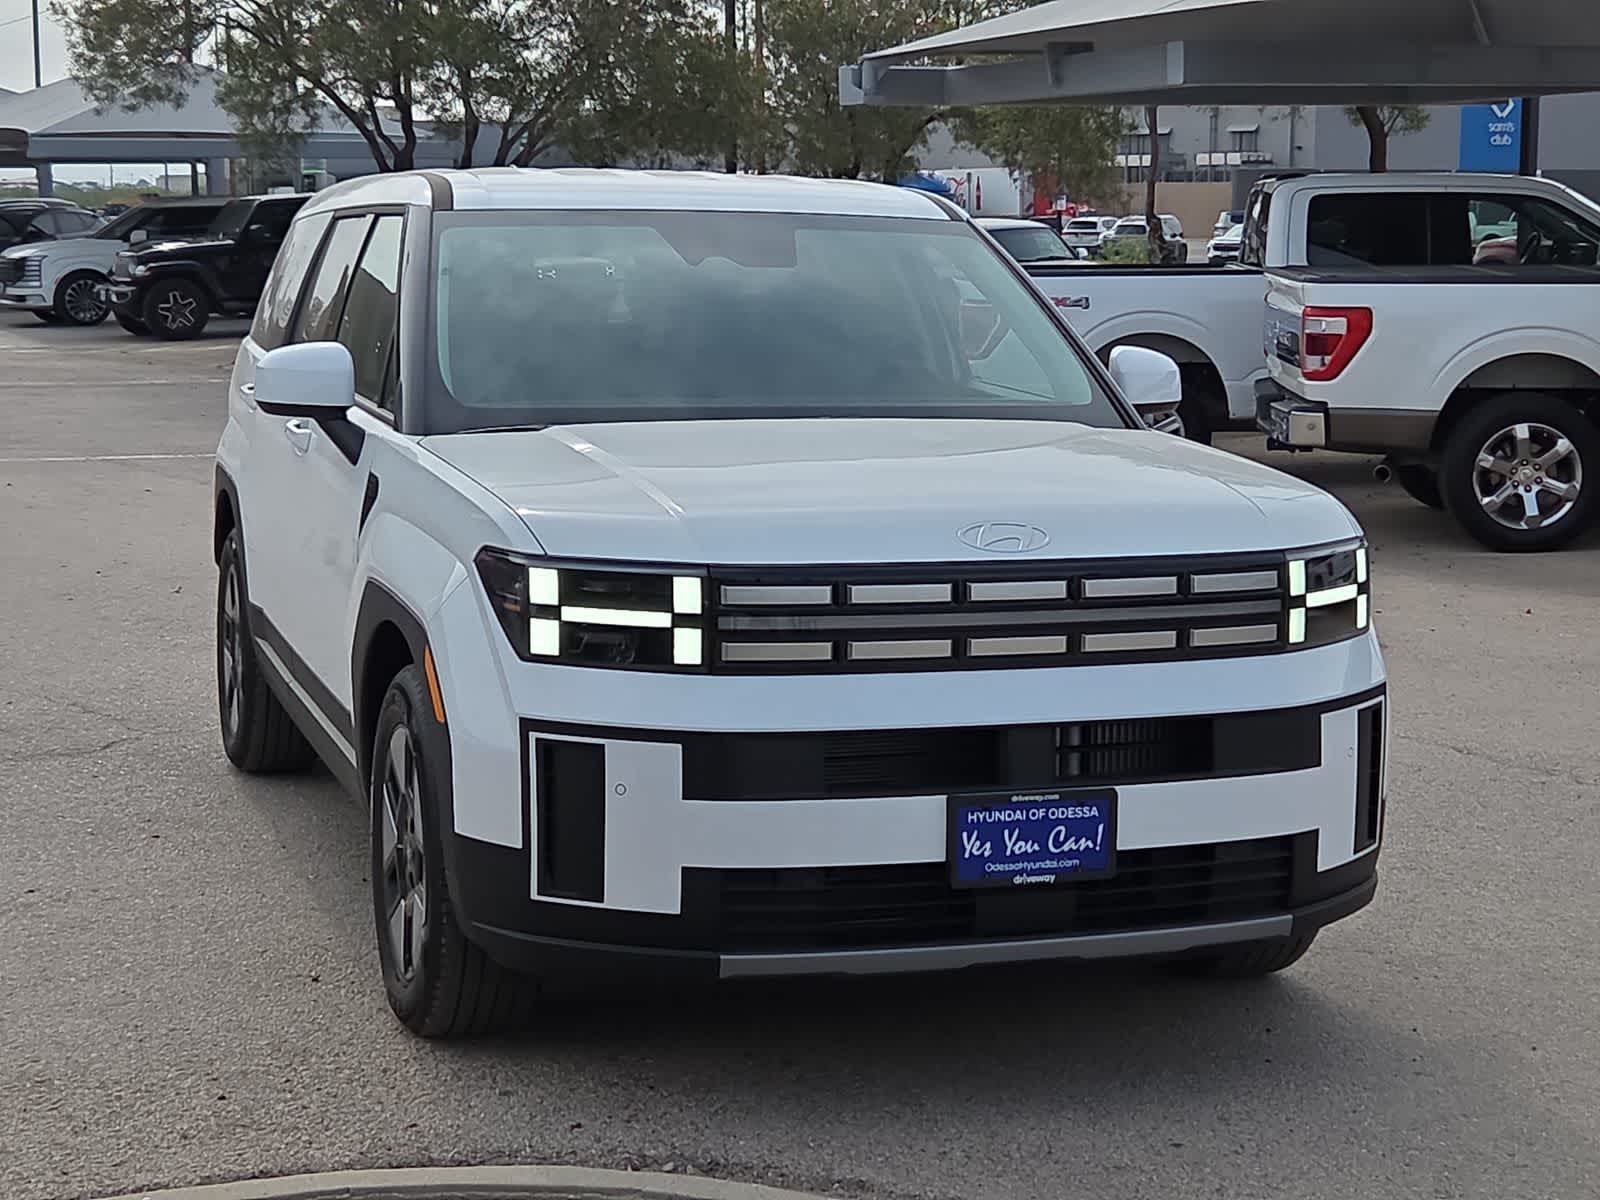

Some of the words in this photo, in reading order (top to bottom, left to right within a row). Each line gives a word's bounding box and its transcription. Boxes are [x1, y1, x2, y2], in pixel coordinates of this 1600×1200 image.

[1490, 134, 1512, 145] club
[967, 809, 1026, 824] HYUNDAI
[1028, 808, 1047, 821] OF
[1048, 806, 1099, 819] ODESSA
[962, 829, 992, 858] Yes
[1003, 827, 1040, 856] You
[1048, 823, 1104, 854] Can!
[984, 858, 1080, 872] OdessaHyundai.com
[1013, 872, 1056, 885] driveway
